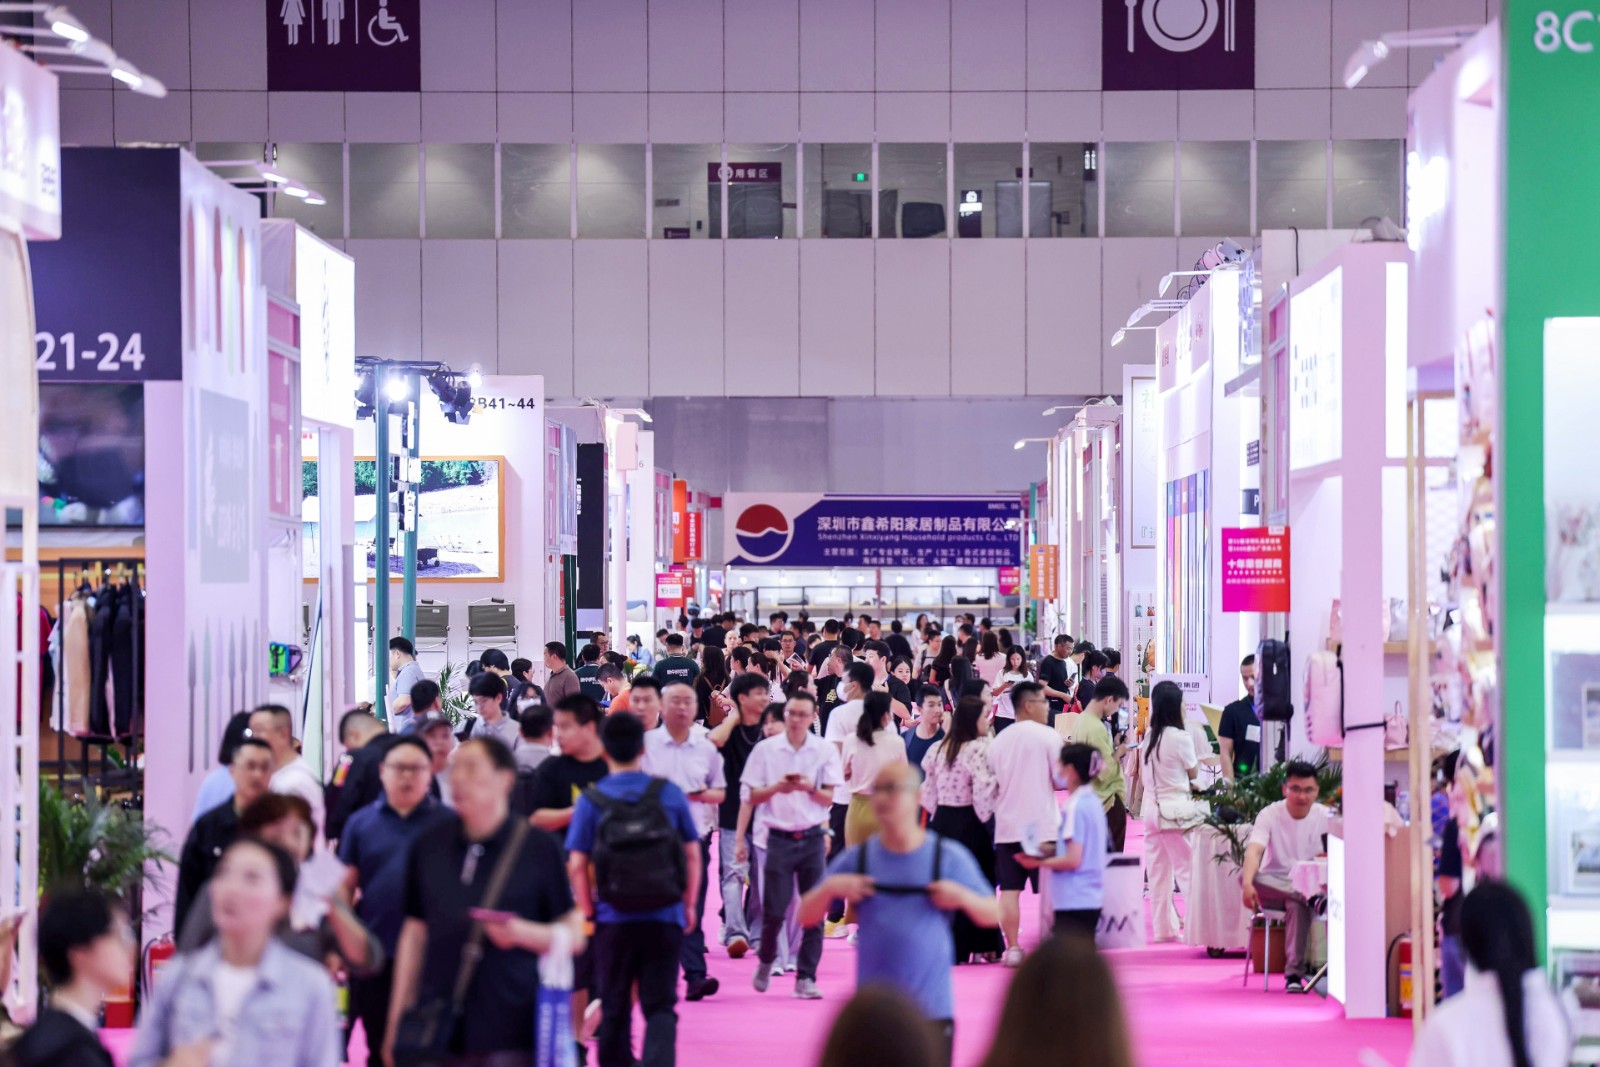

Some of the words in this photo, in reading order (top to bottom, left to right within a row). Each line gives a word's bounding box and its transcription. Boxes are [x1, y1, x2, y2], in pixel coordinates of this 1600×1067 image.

[1534, 9, 1600, 53] 8C
[735, 168, 768, 178] 用餐区
[35, 331, 145, 371] 21-24
[818, 533, 857, 541] Shenzhen
[860, 533, 900, 543] Xinxiyang
[902, 533, 946, 542] Household
[948, 534, 983, 543] products
[1004, 534, 1019, 542] LTD
